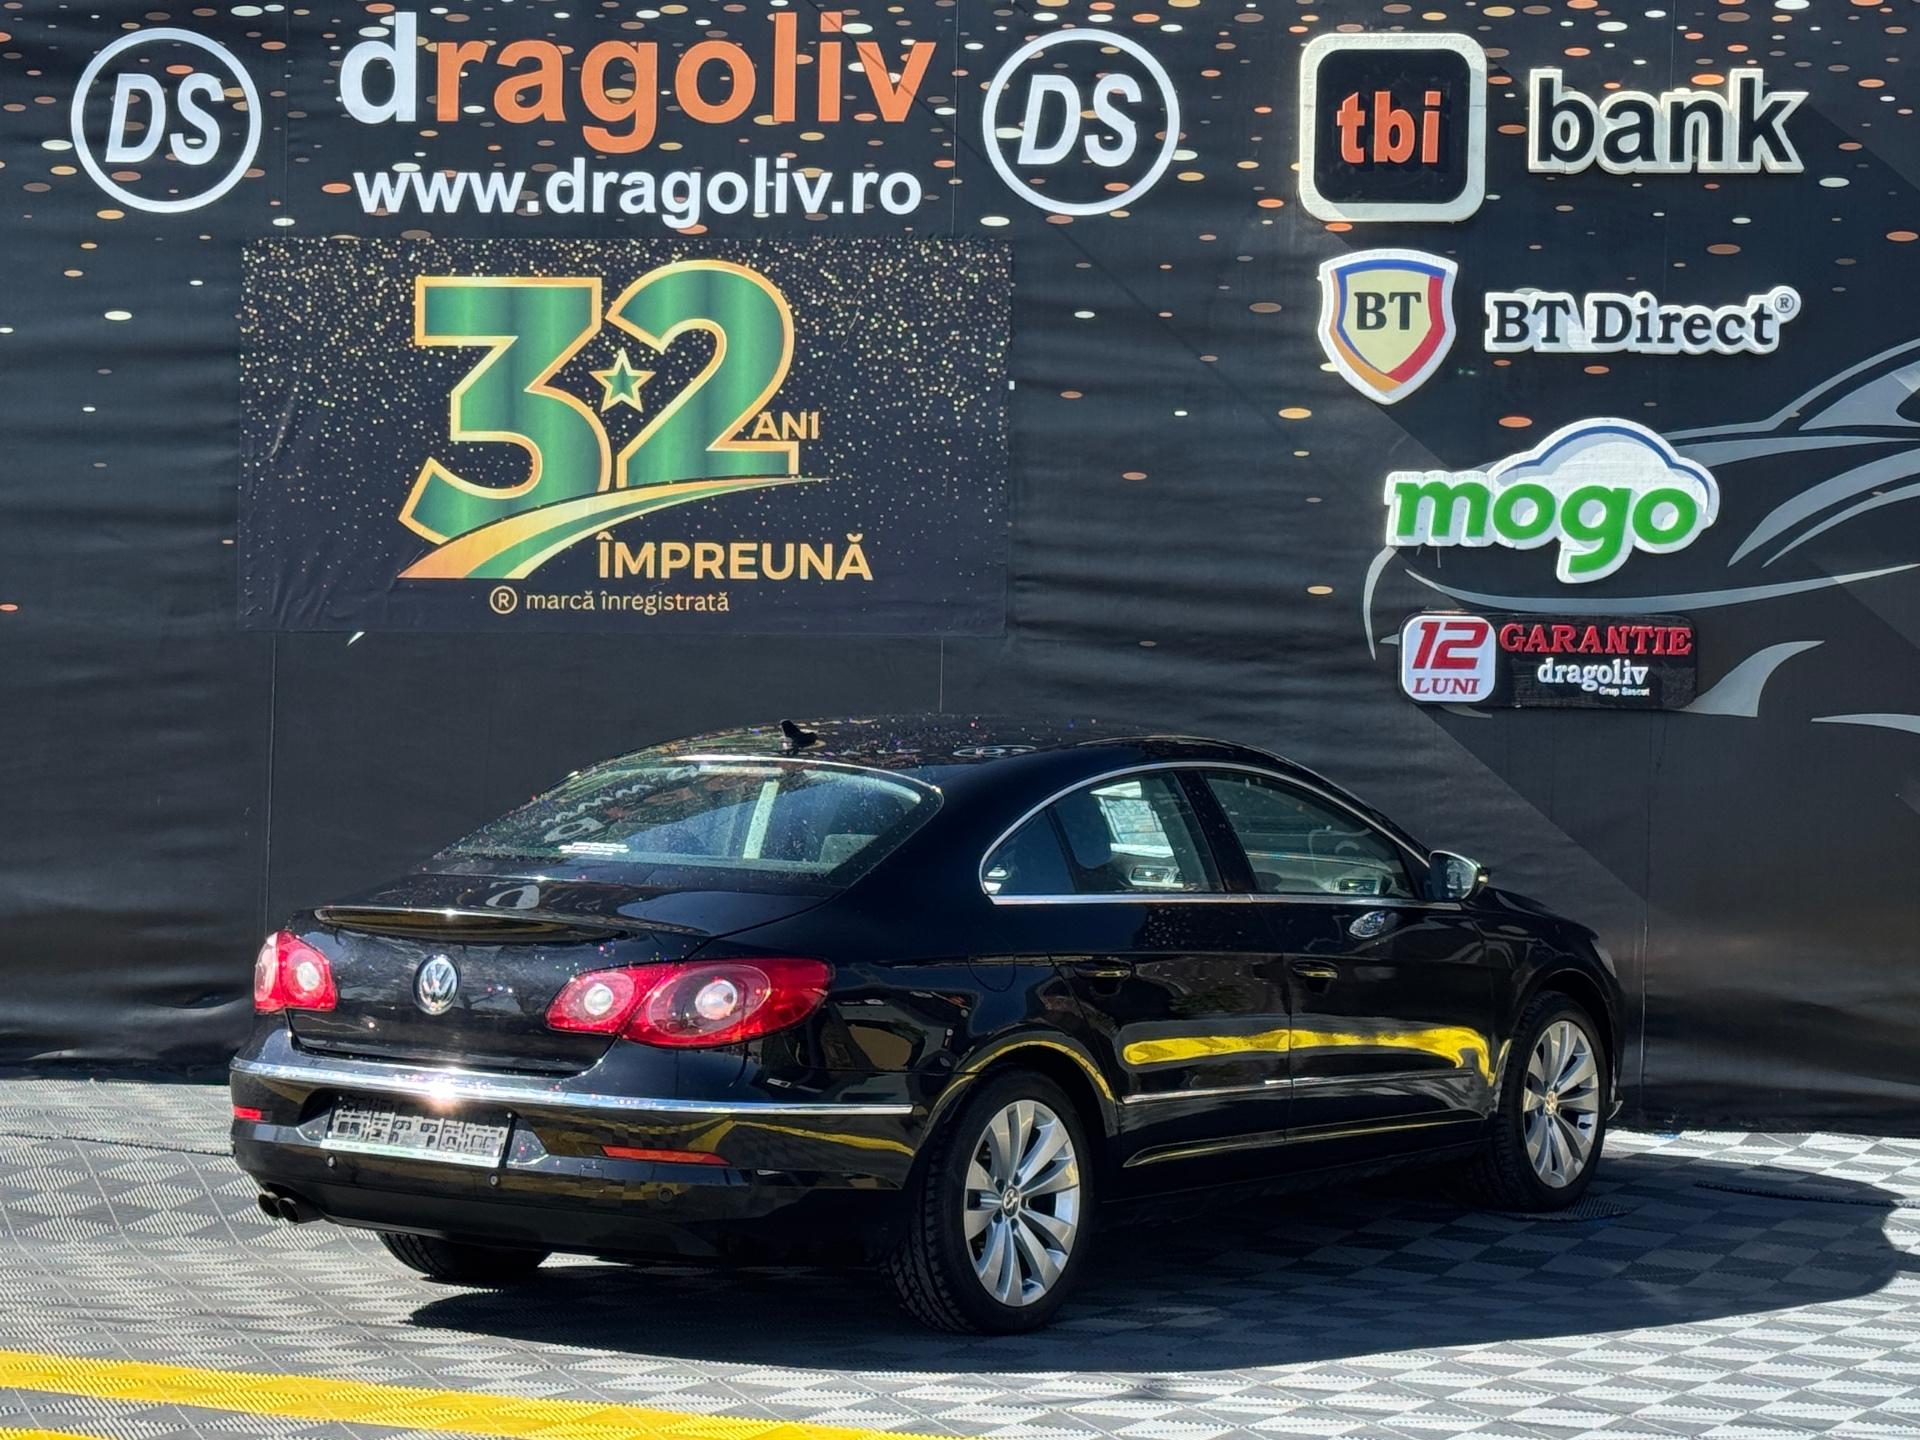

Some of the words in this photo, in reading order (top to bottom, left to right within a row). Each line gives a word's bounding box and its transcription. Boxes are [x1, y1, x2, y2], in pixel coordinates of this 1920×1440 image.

[339, 11, 937, 154] dragoliv
[105, 73, 225, 165] DS
[1017, 73, 1142, 168] DS
[1337, 91, 1441, 164] tbi
[1534, 73, 1801, 168] bank
[353, 157, 922, 231] www.dragoliv.ro
[1355, 291, 1421, 331] BT
[1491, 299, 1571, 344] BT
[398, 259, 796, 546] 32
[751, 411, 820, 441] ANI
[1394, 481, 1698, 574] mogo
[596, 531, 874, 581] ÎMPREUNĂ
[525, 590, 596, 611] marcă
[600, 591, 730, 616] înregistrată
[1412, 621, 1489, 670] 12
[1500, 622, 1694, 656] GARANTIE
[1412, 677, 1481, 695] LUNI
[1537, 657, 1649, 692] dragoliv
